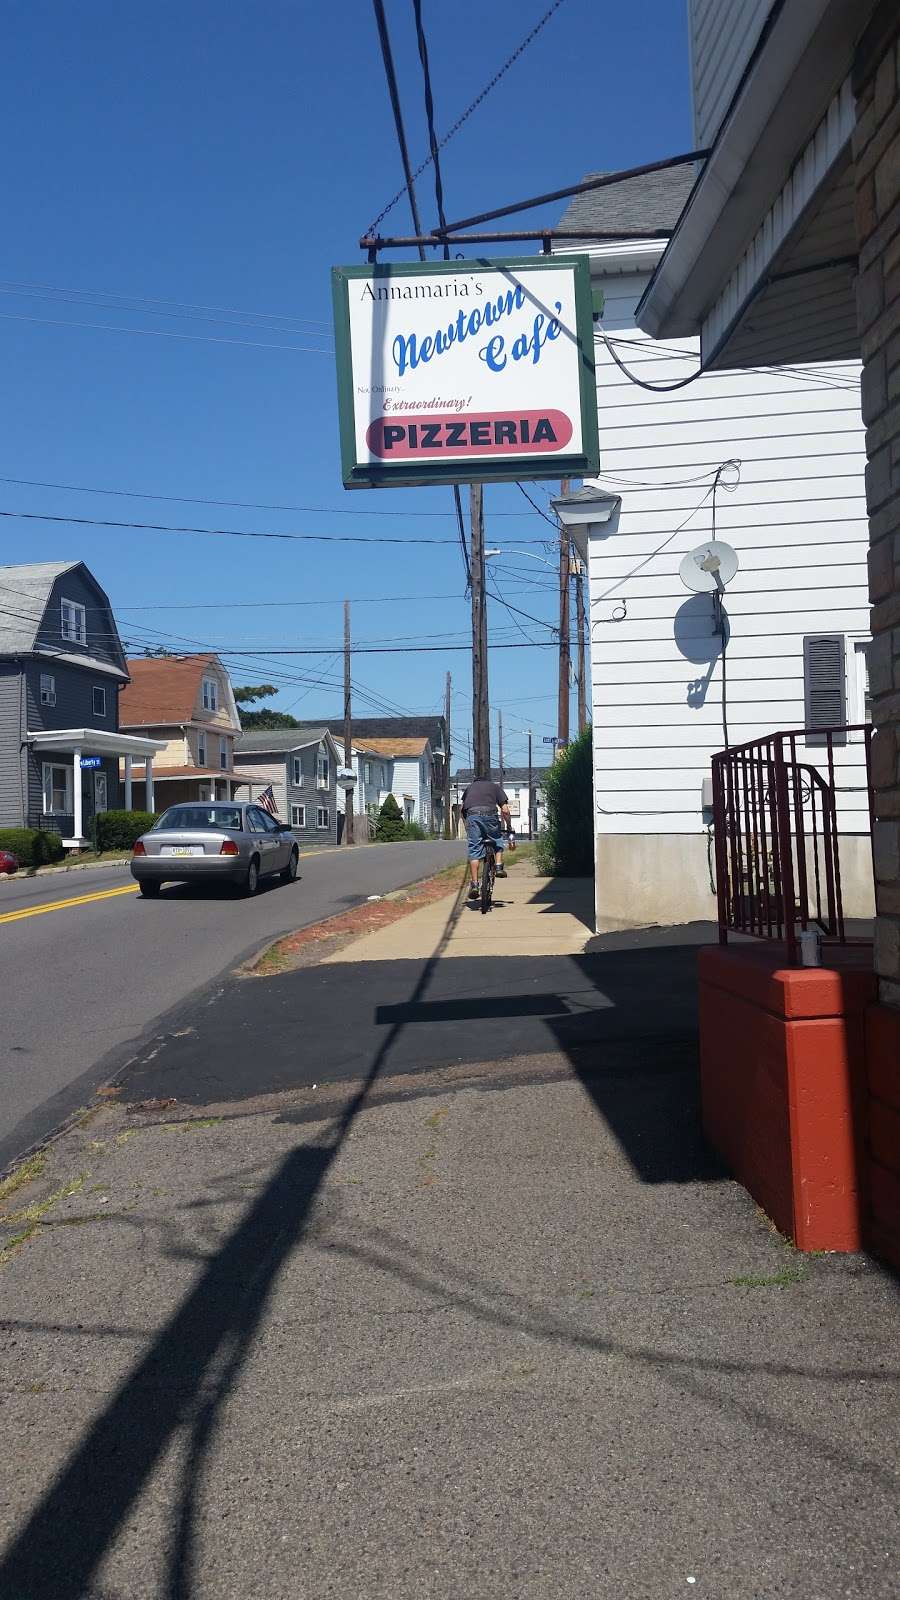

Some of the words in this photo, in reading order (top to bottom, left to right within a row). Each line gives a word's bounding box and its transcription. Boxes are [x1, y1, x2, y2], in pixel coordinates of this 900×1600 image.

[361, 276, 484, 301] Annamaria's
[393, 284, 526, 377] Newtown
[383, 396, 473, 412] Extraordinary!
[383, 418, 558, 450] PIZZERIA
